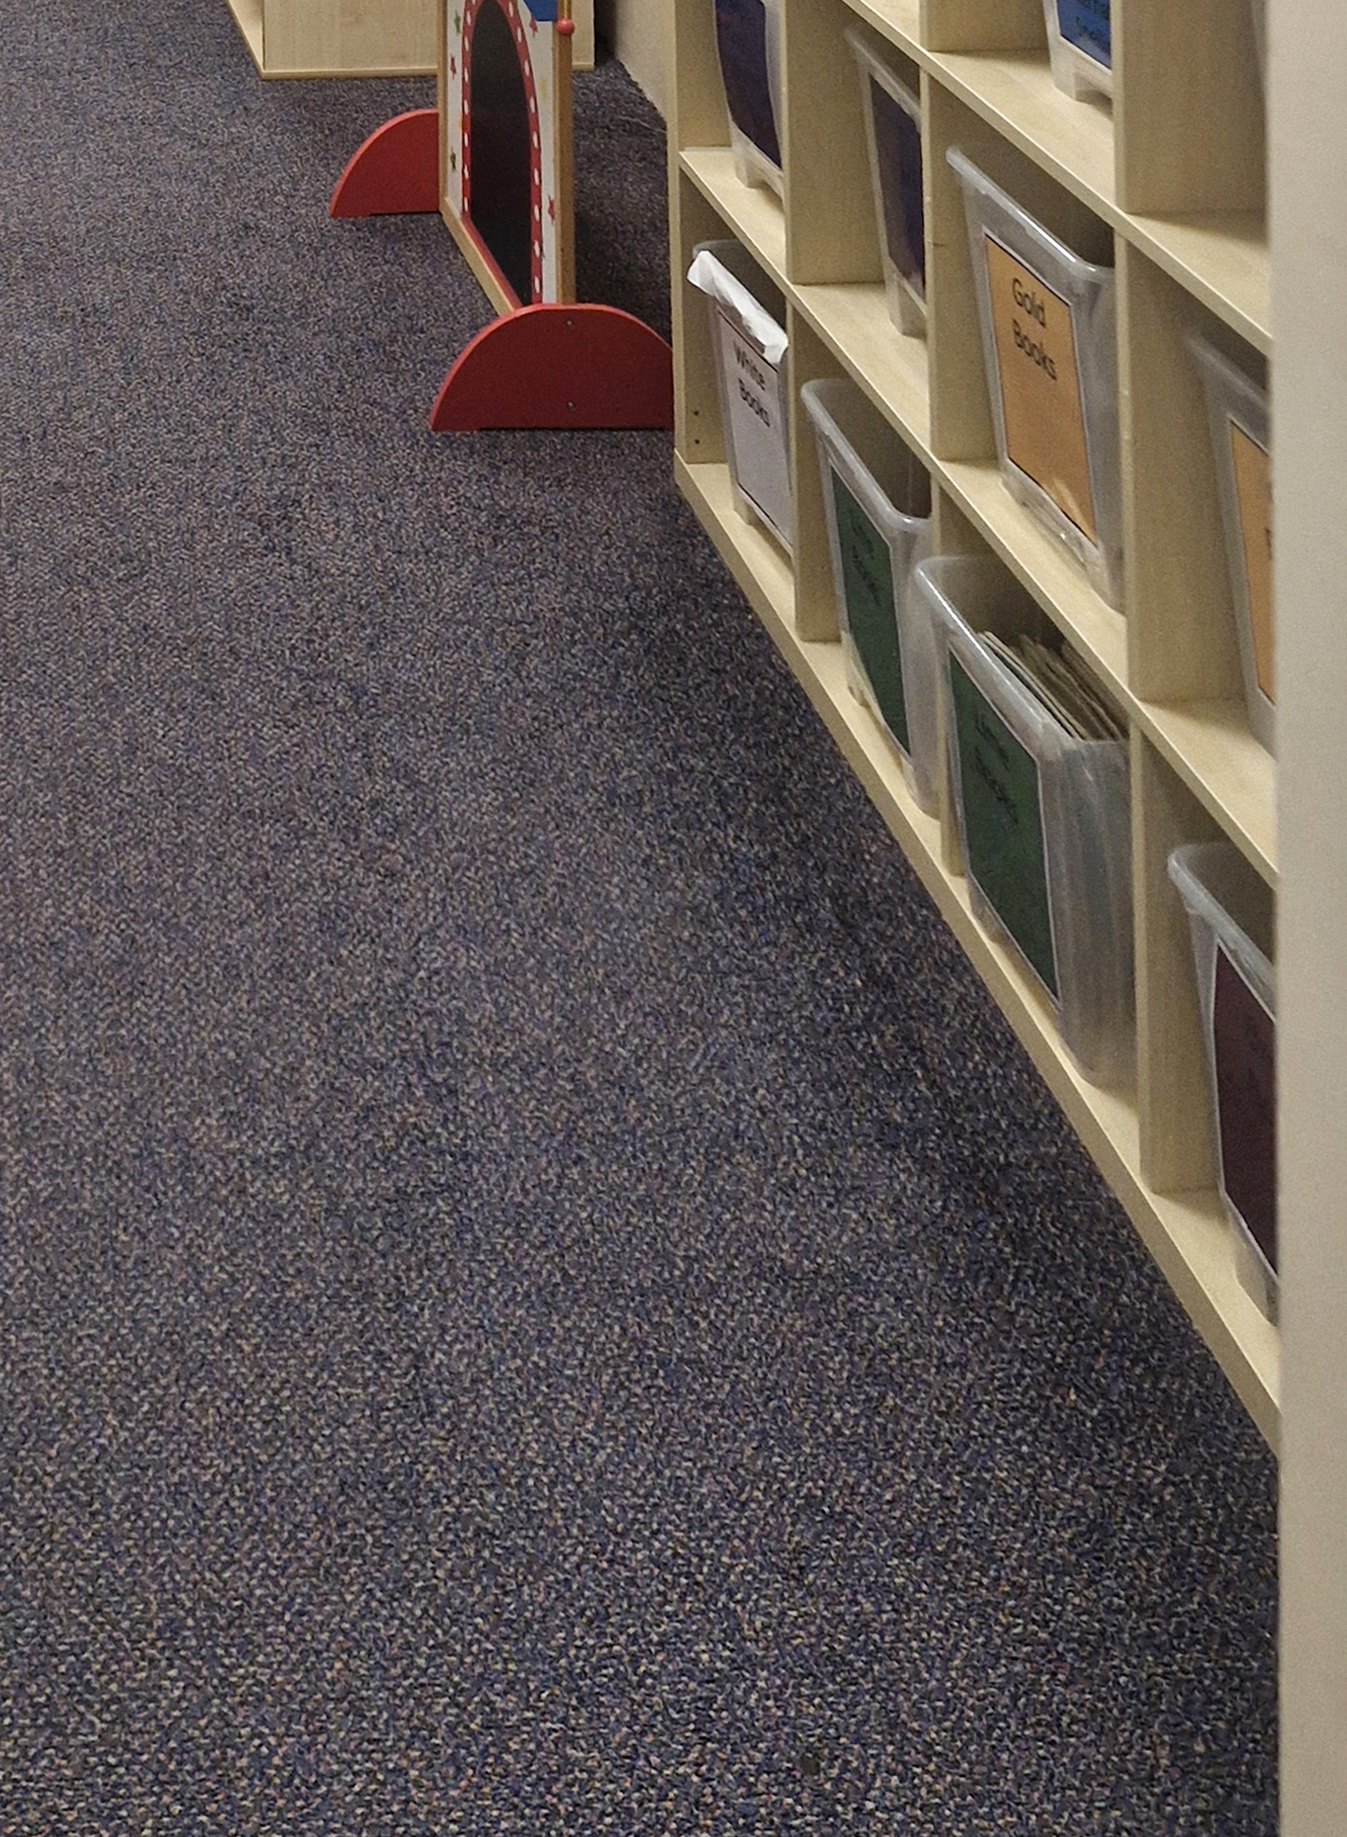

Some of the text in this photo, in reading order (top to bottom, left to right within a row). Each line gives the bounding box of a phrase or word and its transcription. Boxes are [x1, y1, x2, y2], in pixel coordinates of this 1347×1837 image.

[1012, 277, 1048, 329] Gold
[733, 339, 765, 391] White
[1011, 318, 1058, 381] Books
[738, 378, 771, 428] Books
